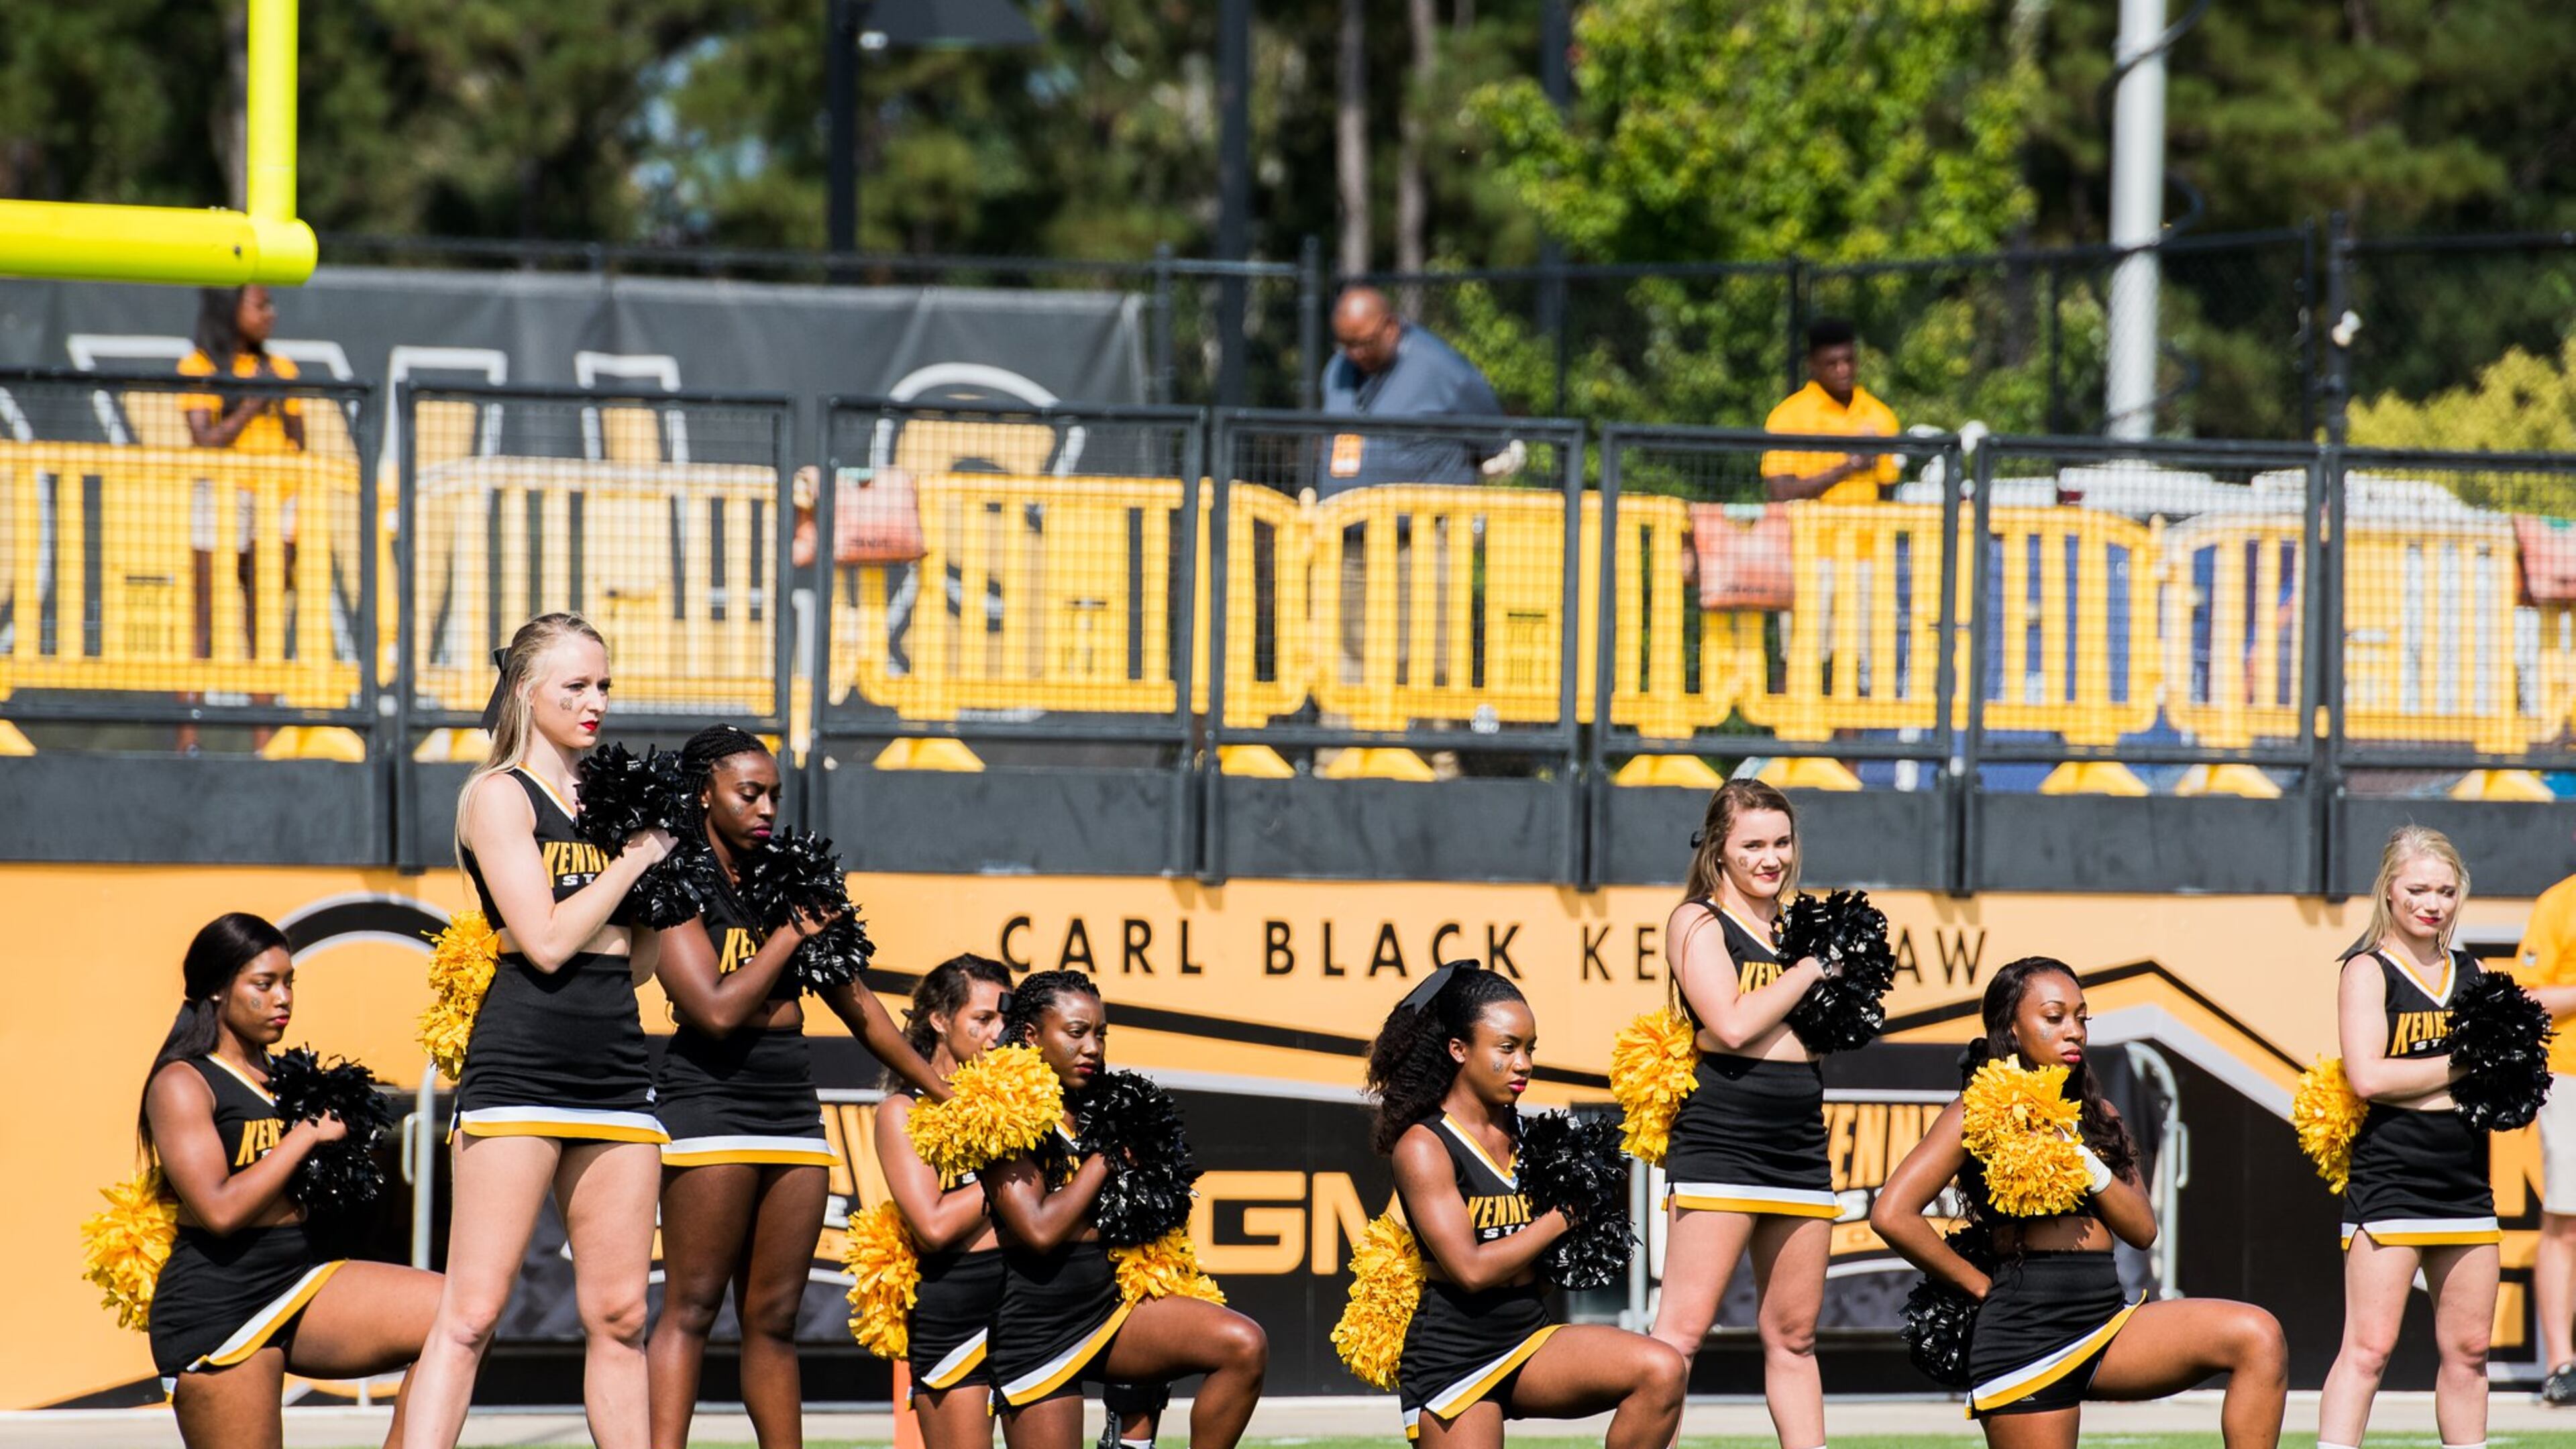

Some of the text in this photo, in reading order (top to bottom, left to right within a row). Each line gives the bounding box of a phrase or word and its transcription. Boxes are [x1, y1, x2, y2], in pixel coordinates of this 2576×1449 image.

[543, 841, 610, 888] KENN
[1000, 916, 1987, 984] CARL BLACK KEAW
[1187, 1171, 1412, 1275] GM
